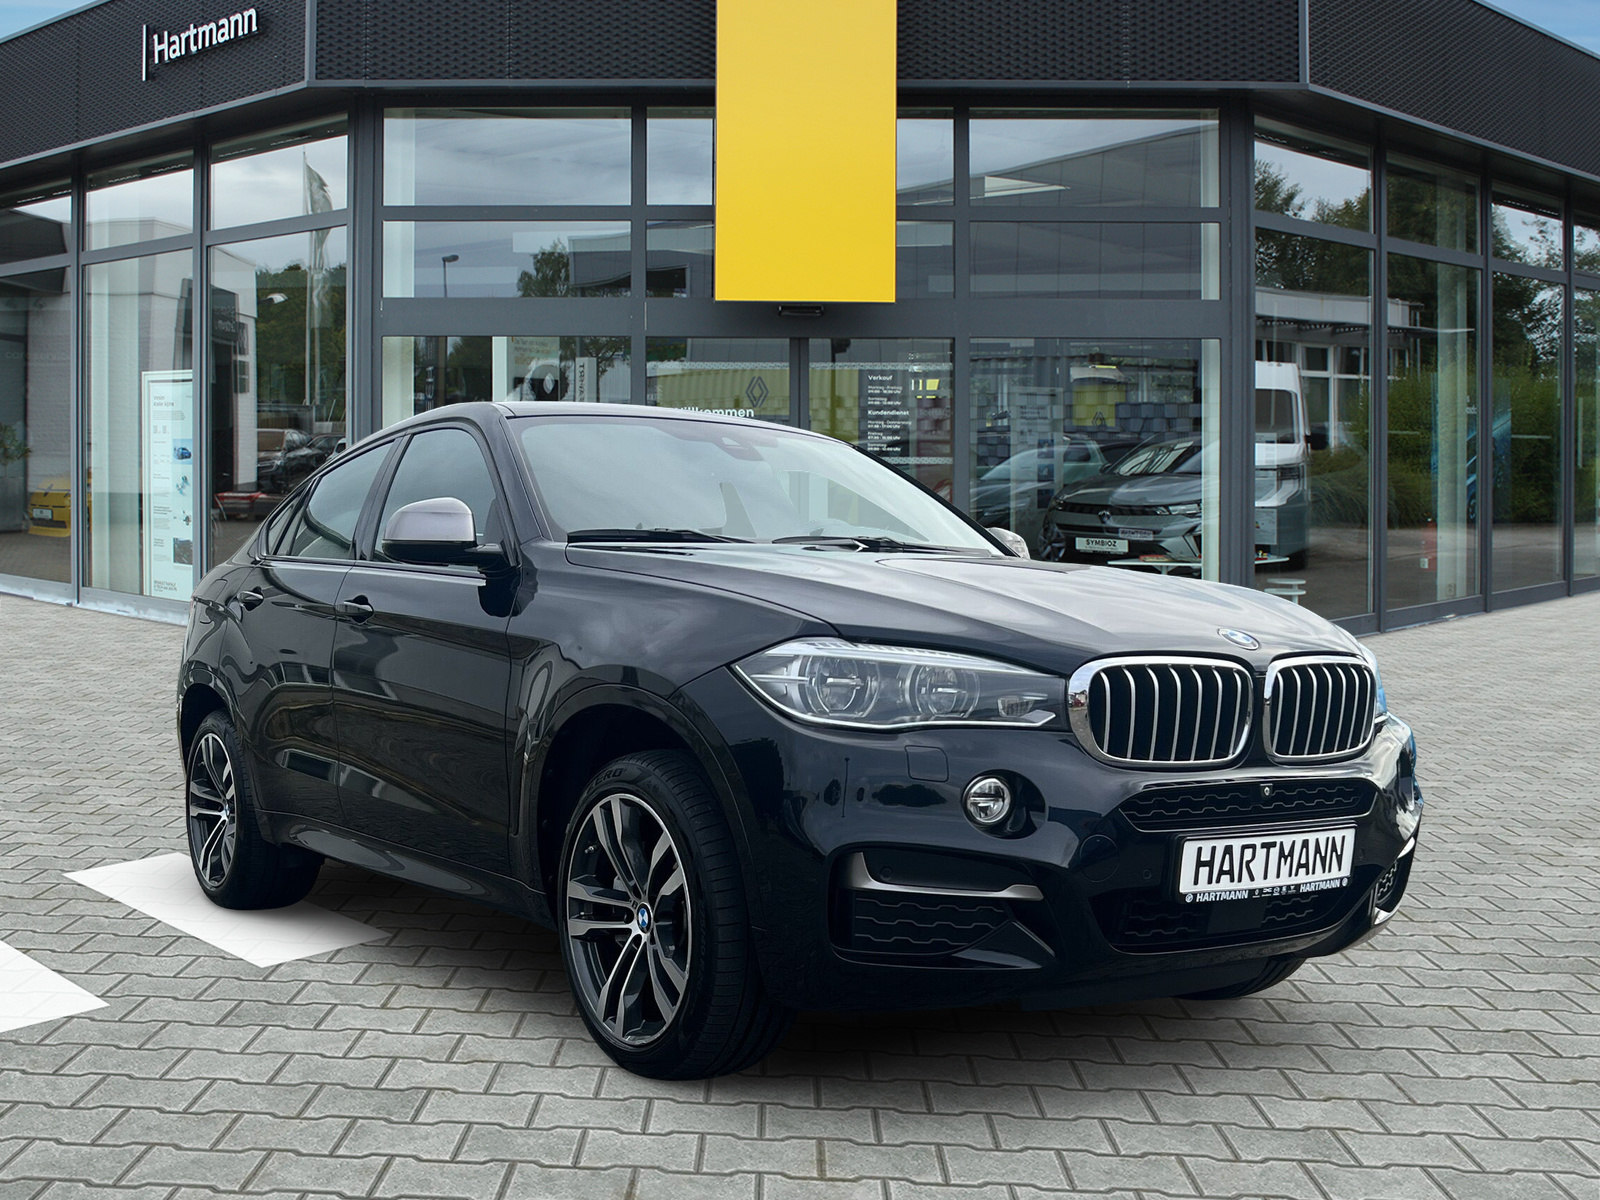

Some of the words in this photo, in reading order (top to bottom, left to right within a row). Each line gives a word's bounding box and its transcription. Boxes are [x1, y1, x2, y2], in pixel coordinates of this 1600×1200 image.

[153, 8, 257, 64] Hartmann
[1086, 539, 1117, 547] SYMBIOZ
[1193, 835, 1346, 886] HARTMANN
[1196, 890, 1249, 902] HARTMANN
[1300, 879, 1340, 893] HARTMANN
